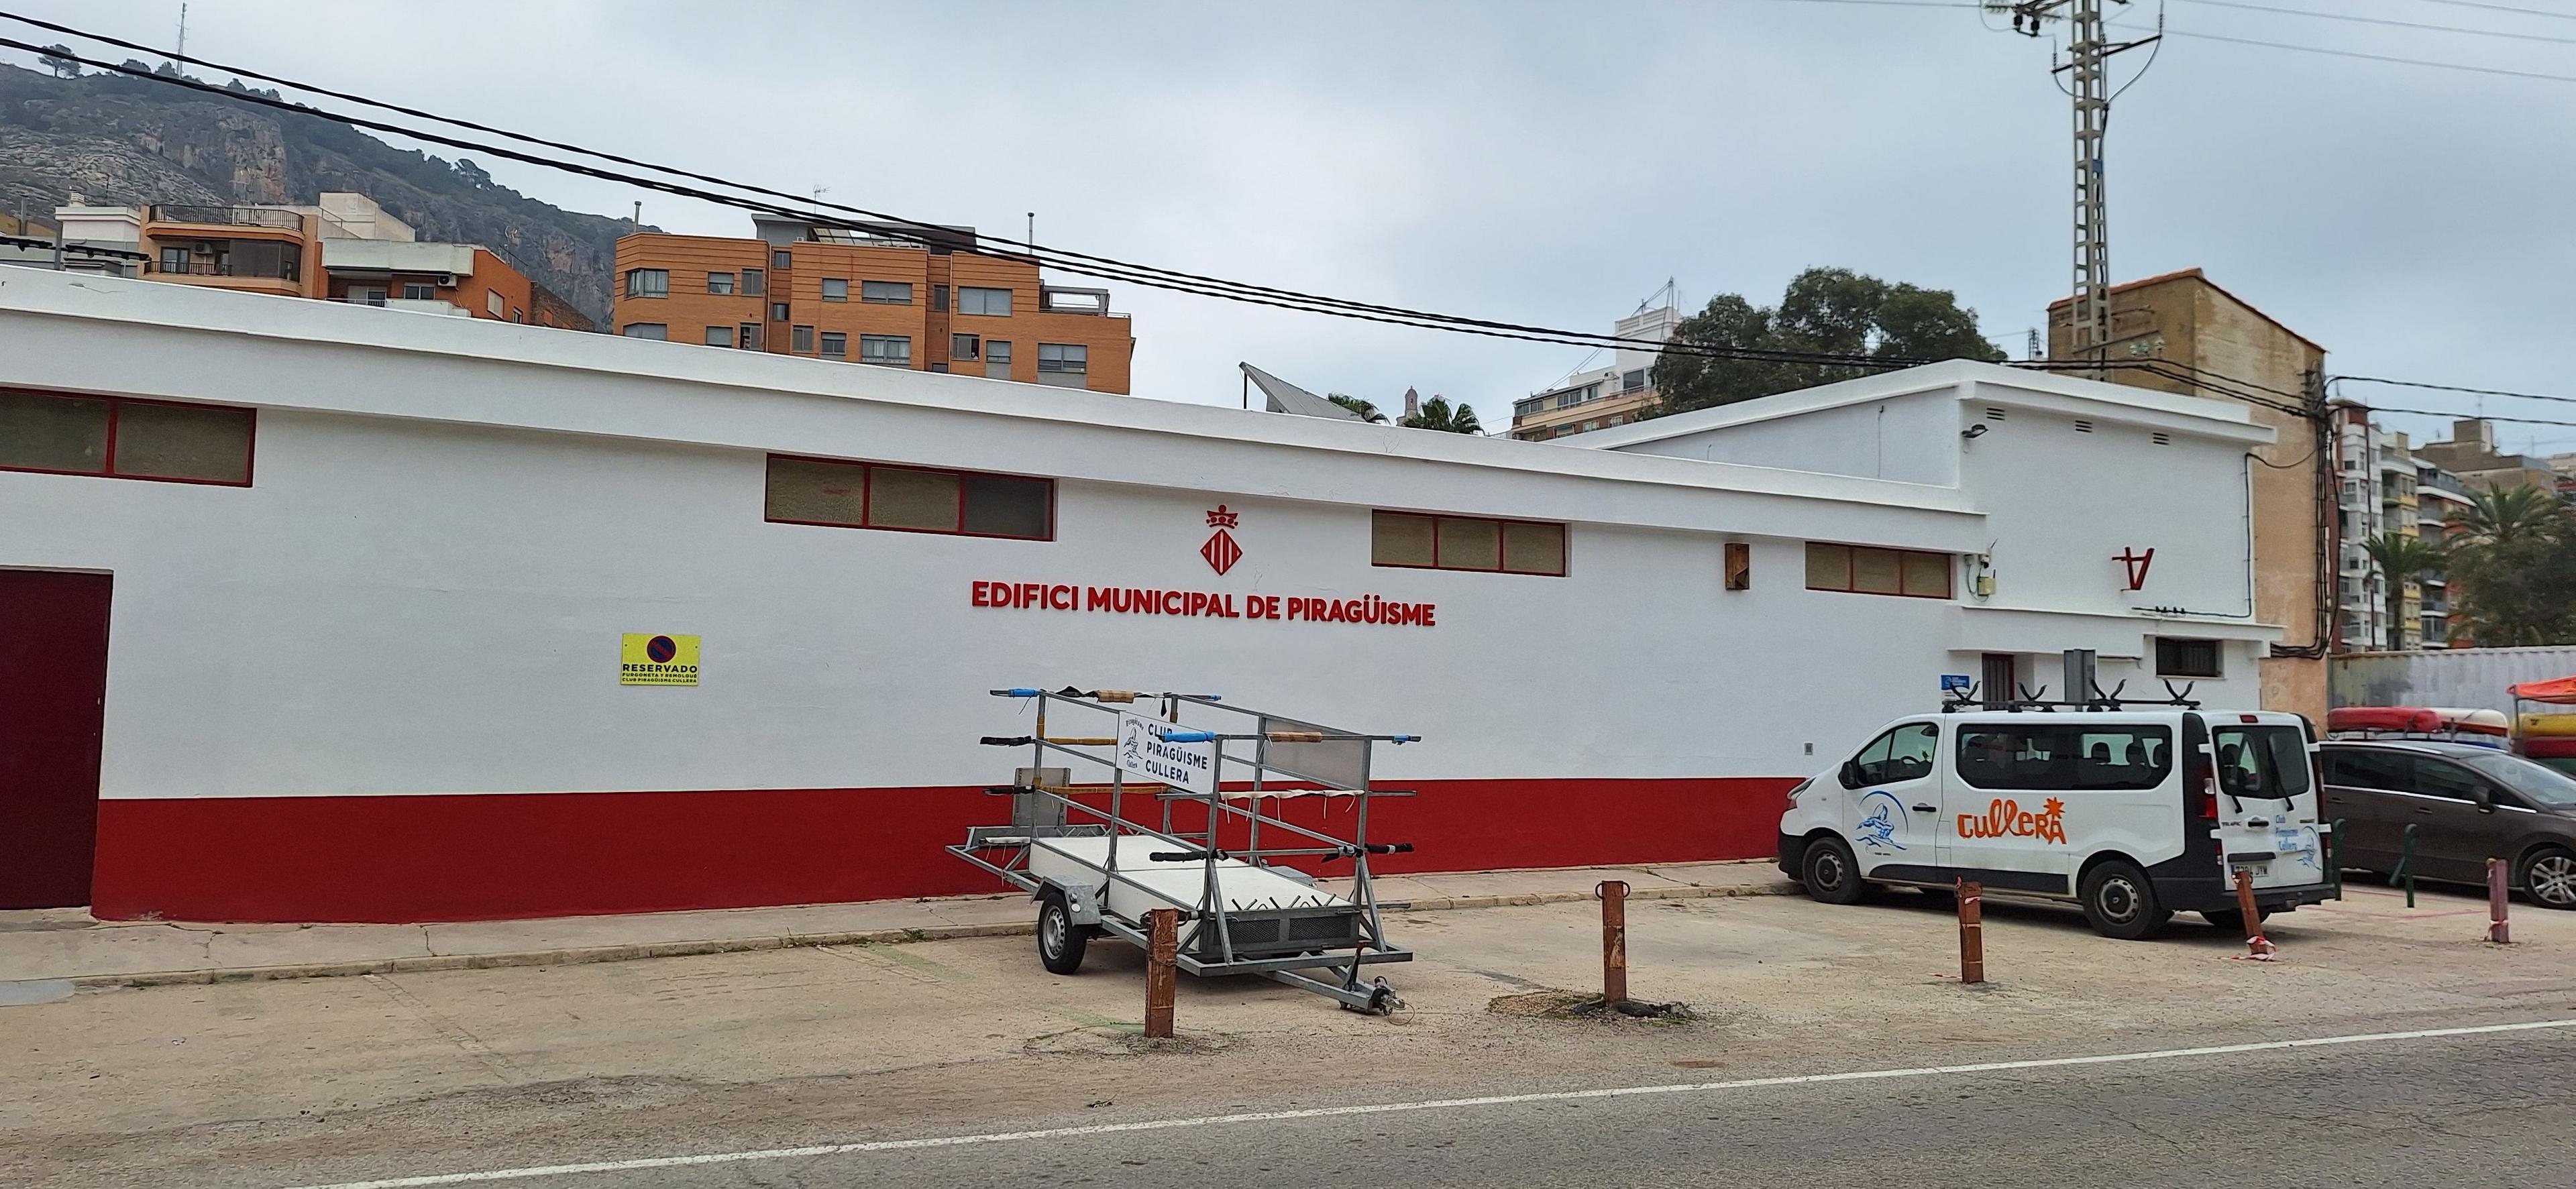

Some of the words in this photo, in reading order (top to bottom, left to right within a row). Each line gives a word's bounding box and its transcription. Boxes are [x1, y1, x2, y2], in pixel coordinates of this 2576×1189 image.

[972, 581, 1079, 610] EDIFICI
[1087, 587, 1240, 618] MUNICIPAL
[1247, 596, 1281, 620] DE
[1287, 594, 1436, 626] PIRAGÜISME
[623, 663, 698, 673] RESERVADO
[1146, 741, 1208, 770] PIRAGÜISME
[1145, 759, 1189, 784] CULLERA
